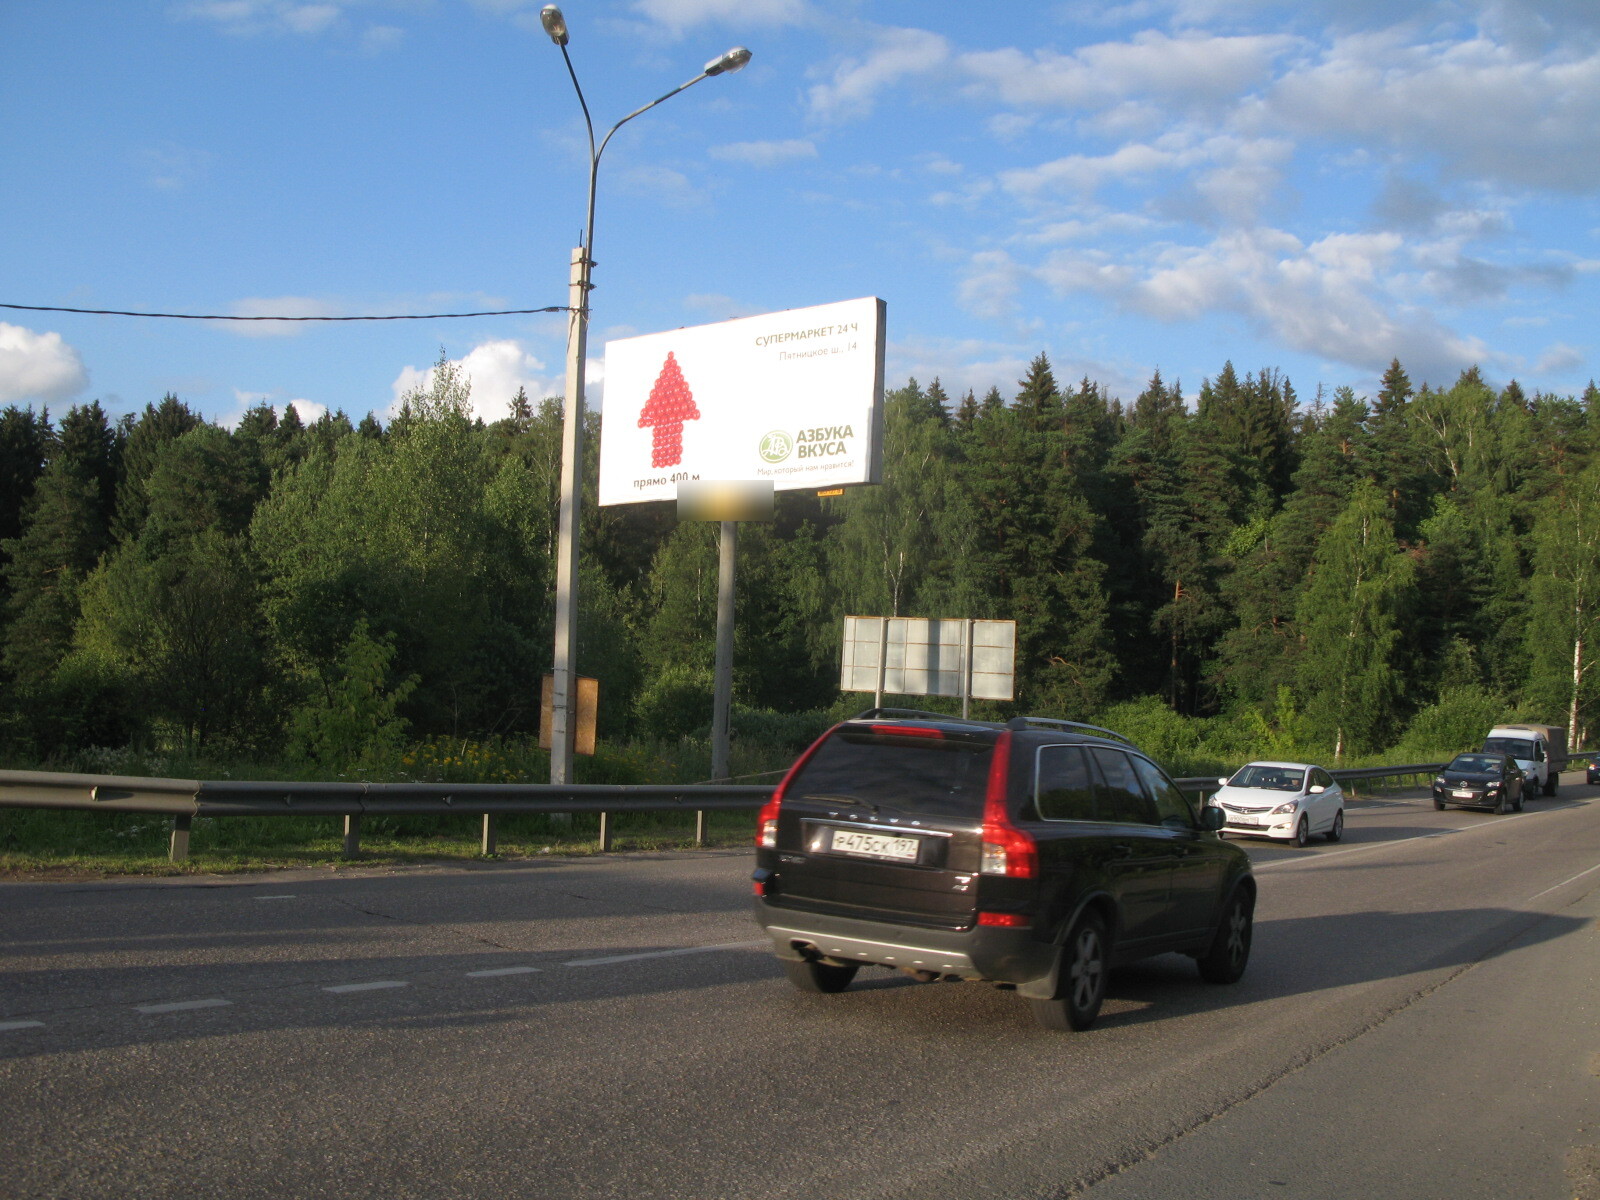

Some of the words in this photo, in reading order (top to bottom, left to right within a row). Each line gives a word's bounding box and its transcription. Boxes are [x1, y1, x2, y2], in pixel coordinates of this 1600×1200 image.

[755, 326, 834, 347] СУПЕРМАРКЕТ
[837, 324, 849, 335] 24
[851, 322, 859, 332] Ч
[779, 348, 829, 361] Пятницкое
[848, 341, 857, 352] 14
[796, 424, 854, 444] АЗБУКА
[798, 441, 847, 459] ВКУСА
[774, 465, 804, 476] который
[633, 477, 667, 490] прямо
[670, 472, 688, 484] 400
